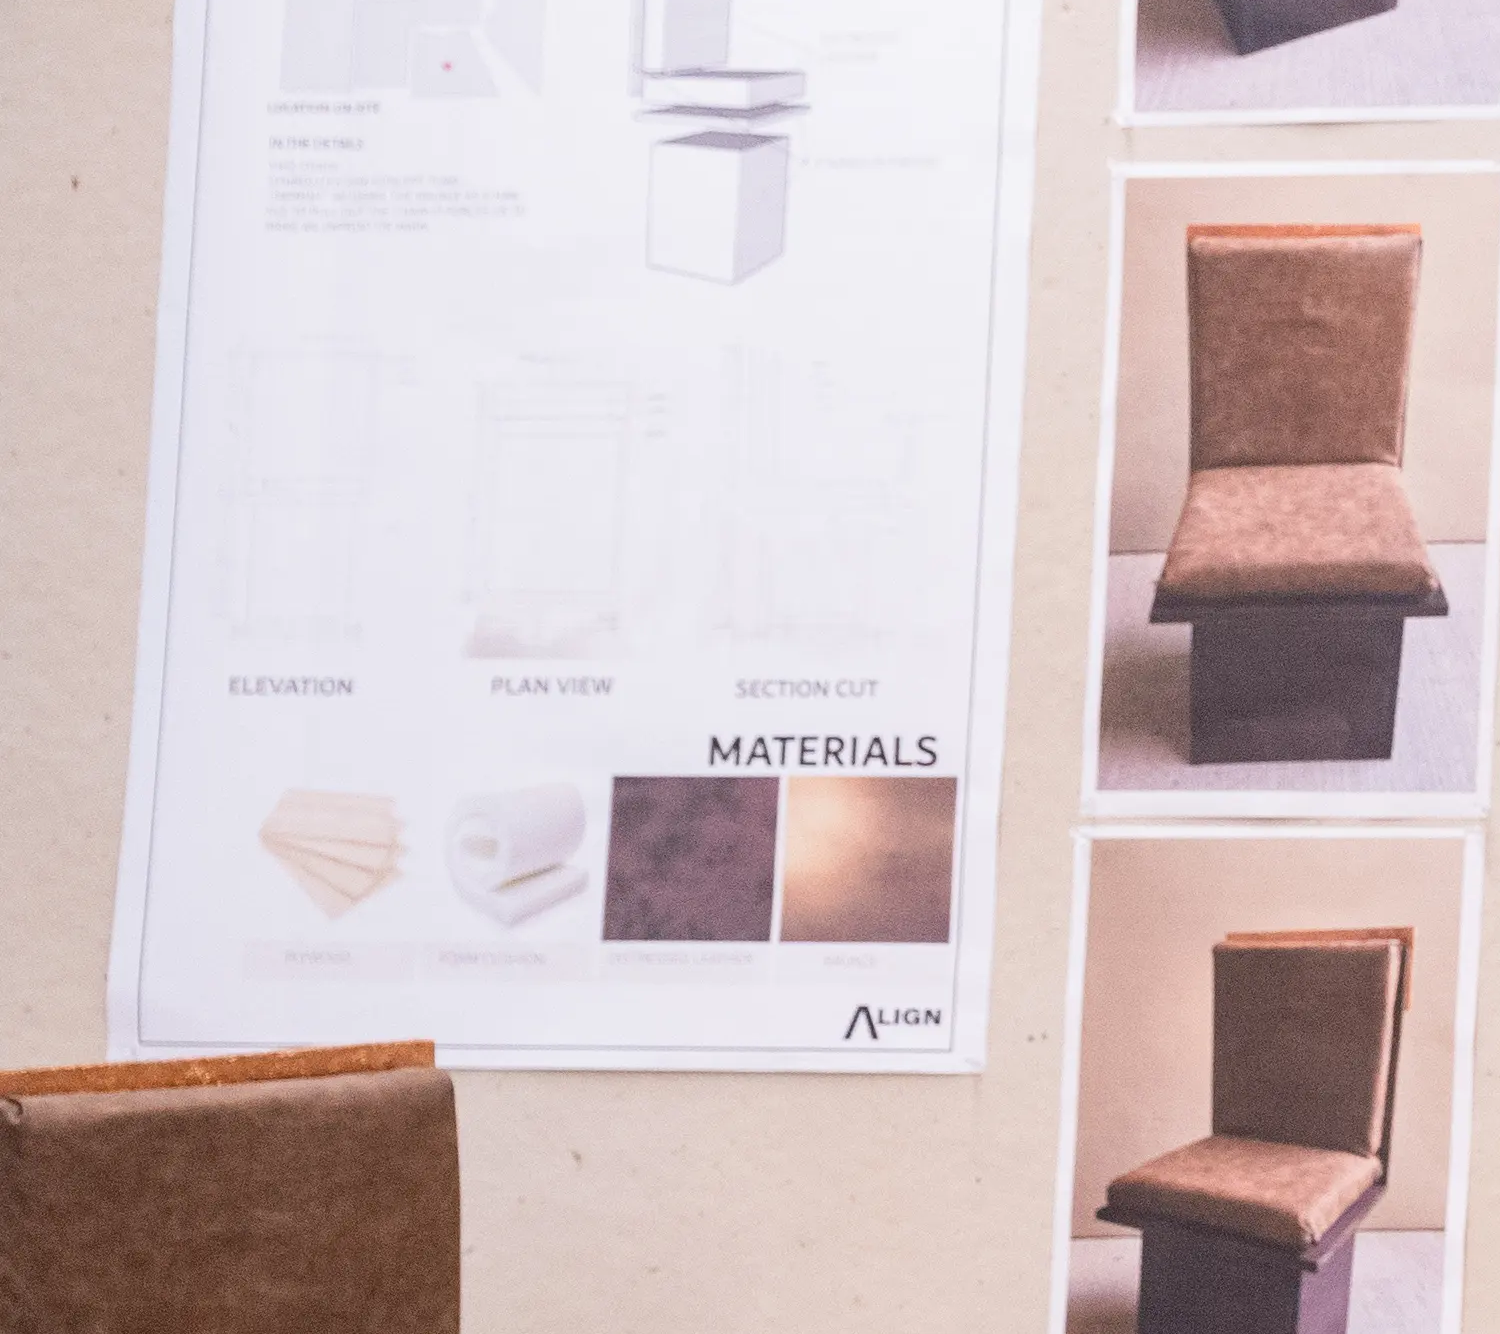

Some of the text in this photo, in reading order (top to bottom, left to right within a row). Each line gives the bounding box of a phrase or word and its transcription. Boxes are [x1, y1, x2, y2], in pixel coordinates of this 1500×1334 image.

[228, 676, 354, 696] ELEVATION
[491, 676, 613, 696] PLAN VIEW
[735, 679, 879, 698] SECTION CUT
[709, 735, 939, 767] MATERIALS
